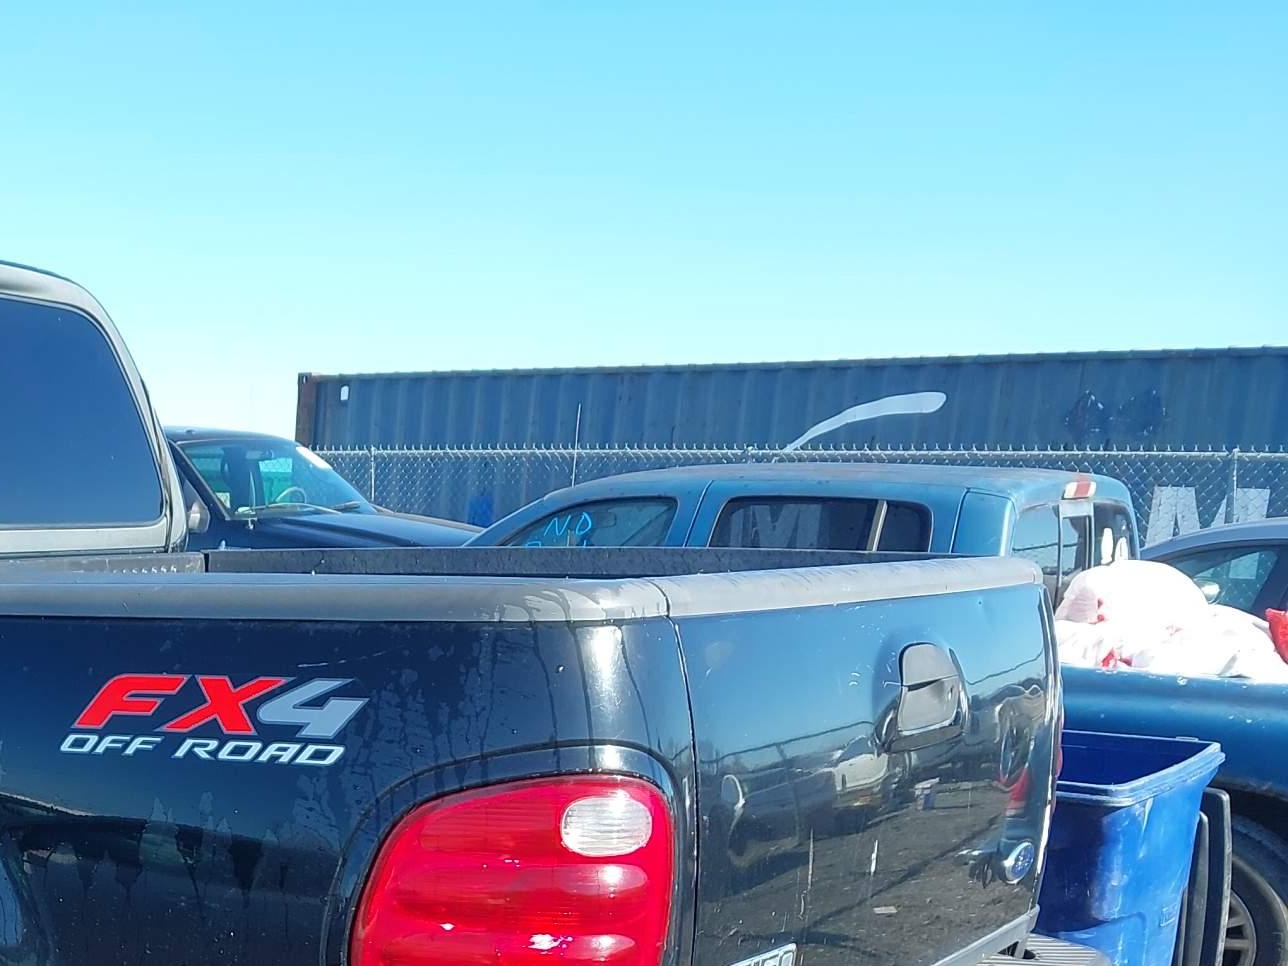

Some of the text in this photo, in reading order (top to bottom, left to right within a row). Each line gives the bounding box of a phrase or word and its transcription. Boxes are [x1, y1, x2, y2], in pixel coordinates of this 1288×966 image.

[70, 672, 371, 740] FX4
[59, 732, 346, 767] OFF ROAD
